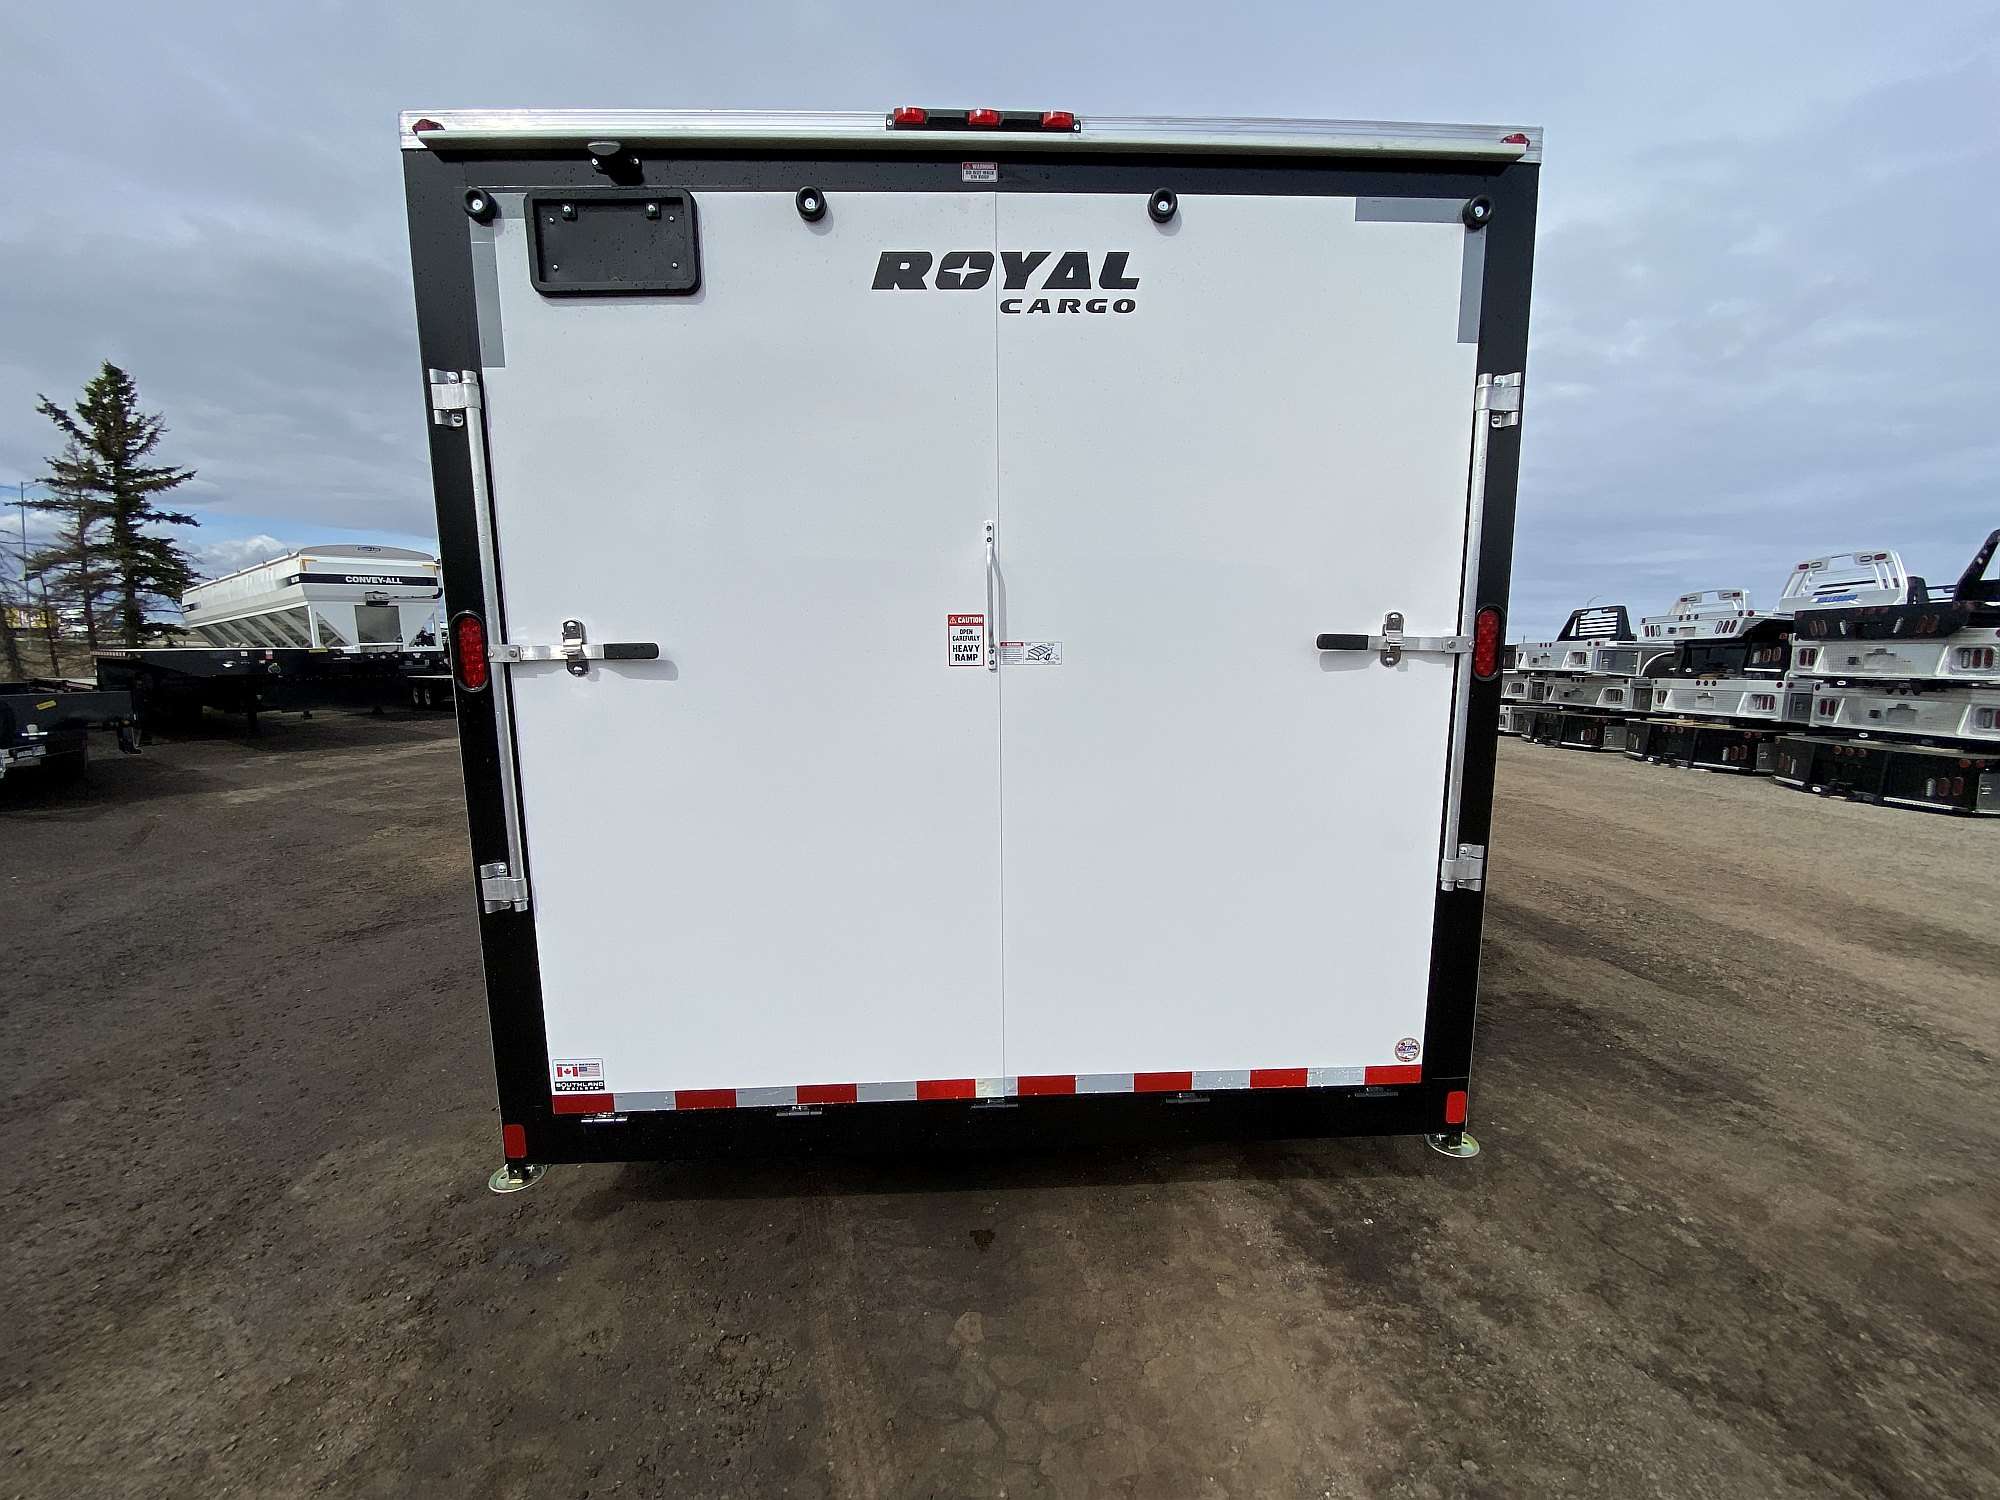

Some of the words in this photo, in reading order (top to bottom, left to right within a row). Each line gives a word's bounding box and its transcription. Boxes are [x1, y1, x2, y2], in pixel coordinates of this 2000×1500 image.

[871, 251, 1140, 290] ROYAL
[1000, 298, 1136, 314] CARGO
[345, 575, 403, 584] CONVEY-ALL
[957, 616, 983, 624] CAUTION
[952, 644, 980, 653] HEAVY
[954, 653, 978, 662] RAMP
